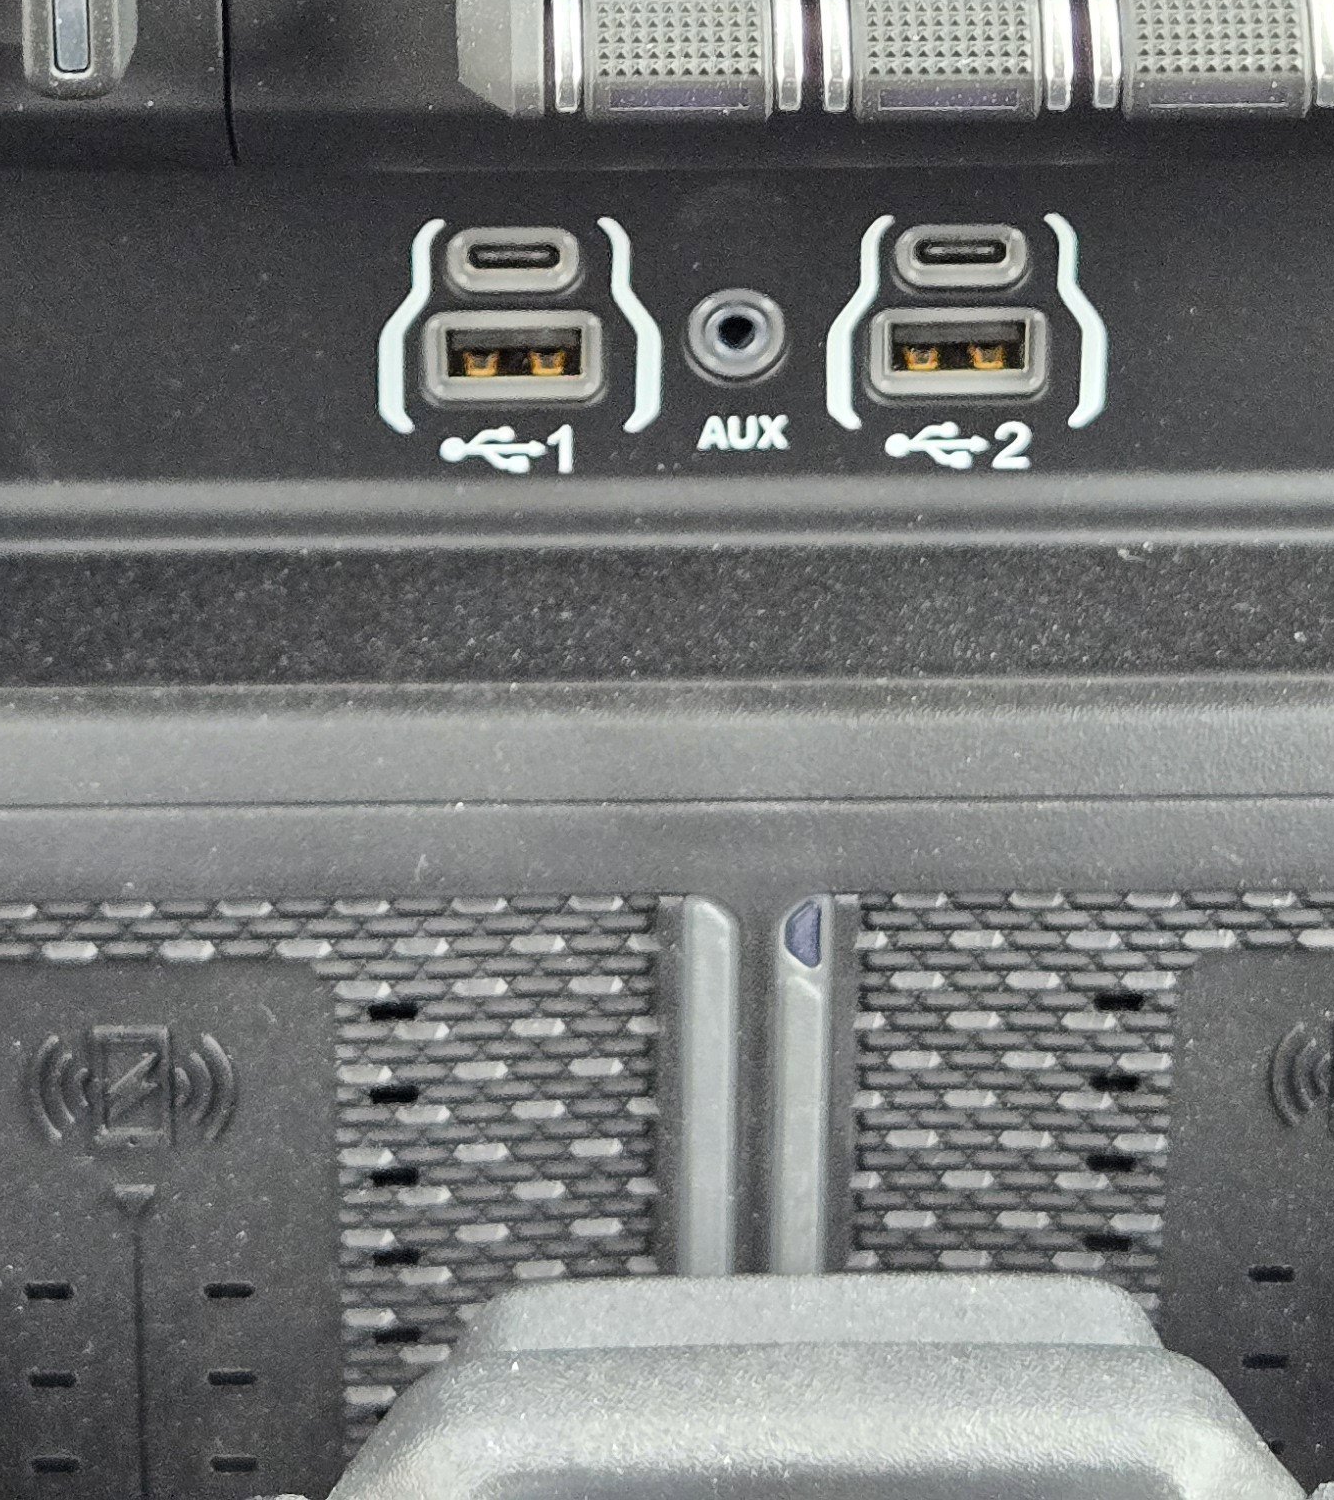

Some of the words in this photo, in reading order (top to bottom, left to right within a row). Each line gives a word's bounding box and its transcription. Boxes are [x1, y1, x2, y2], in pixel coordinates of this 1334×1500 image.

[546, 424, 574, 474] 1
[696, 414, 789, 450] AUX
[991, 420, 1032, 470] 2
